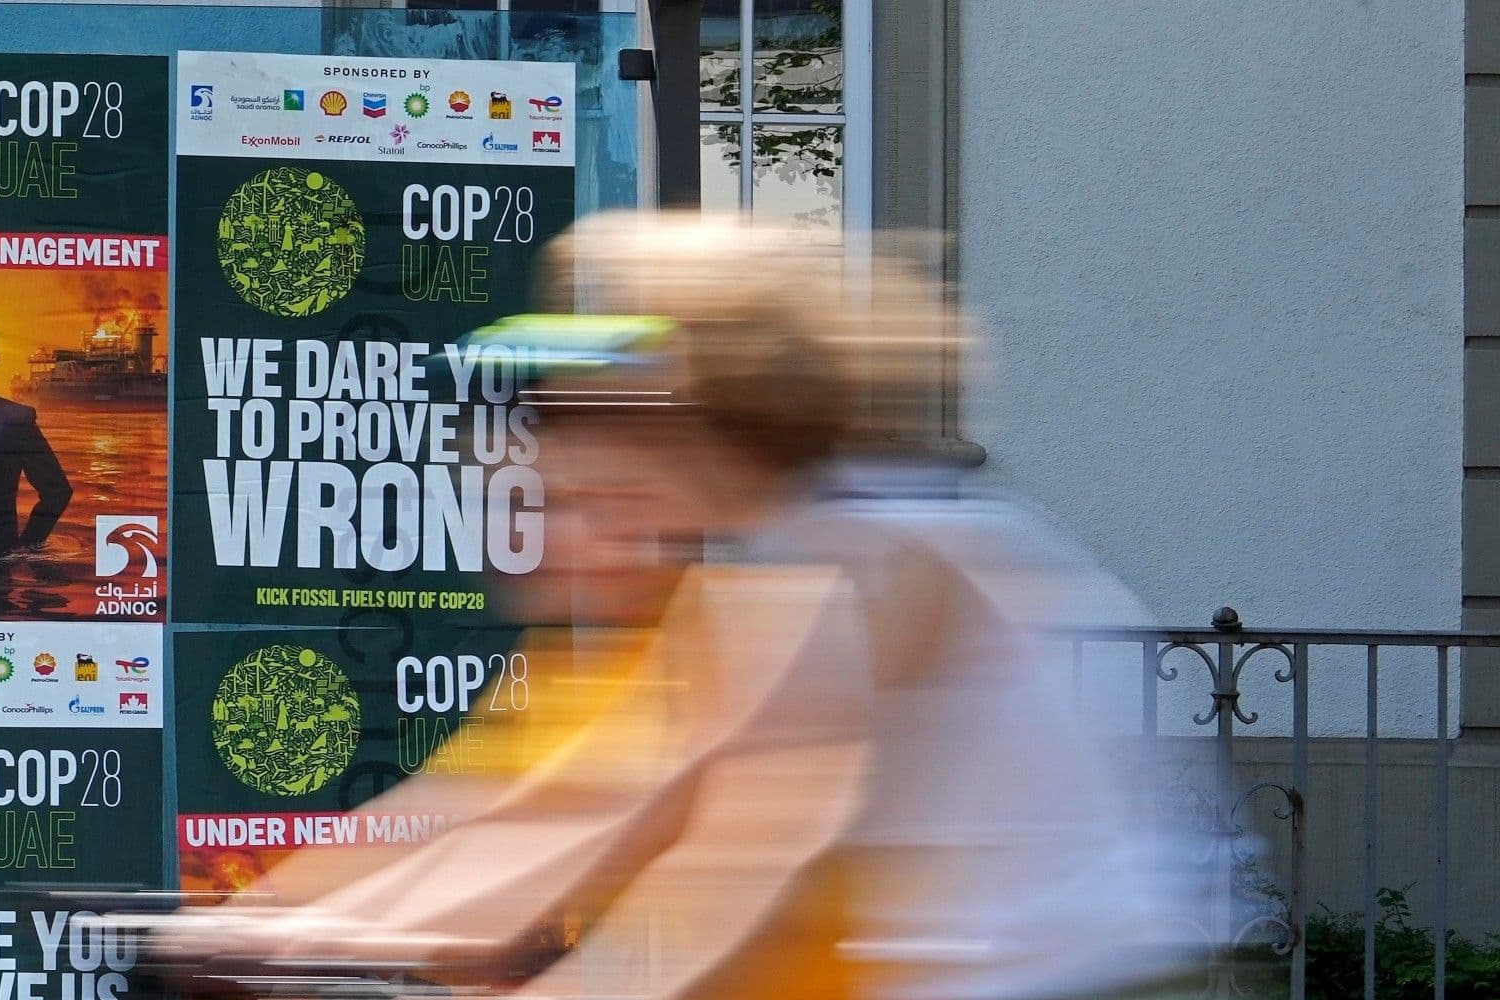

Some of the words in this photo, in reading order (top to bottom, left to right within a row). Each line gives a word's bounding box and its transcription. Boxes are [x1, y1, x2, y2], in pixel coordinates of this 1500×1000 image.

[324, 67, 407, 78] SPONSORED
[413, 70, 430, 79] BY
[420, 83, 431, 92] bp
[491, 108, 509, 119] eni
[241, 136, 300, 147] ExxonMobil
[328, 135, 371, 144] REPSOL
[378, 146, 405, 155] Statoil
[417, 141, 467, 151] ConocoPhillips
[402, 245, 489, 303] UAE
[201, 338, 282, 399] WE
[296, 339, 430, 401] DARE
[208, 399, 275, 460] TO
[289, 400, 460, 463] PROVE
[472, 403, 540, 465] US
[203, 460, 545, 575] WRONG
[257, 588, 289, 606] KICK
[292, 589, 339, 607] FOSSIL
[342, 590, 384, 608] FUELS
[387, 590, 415, 609] OUT
[419, 591, 436, 609] OF
[439, 592, 485, 610] COP28
[95, 601, 157, 616] ADNOC
[4, 647, 15, 655] bp
[77, 670, 96, 681] eni
[2, 705, 53, 715] ConocoPhillips
[398, 716, 486, 776] UAE
[186, 818, 286, 848] UNDER
[293, 816, 358, 846] NEW
[31, 911, 137, 972] YOU
